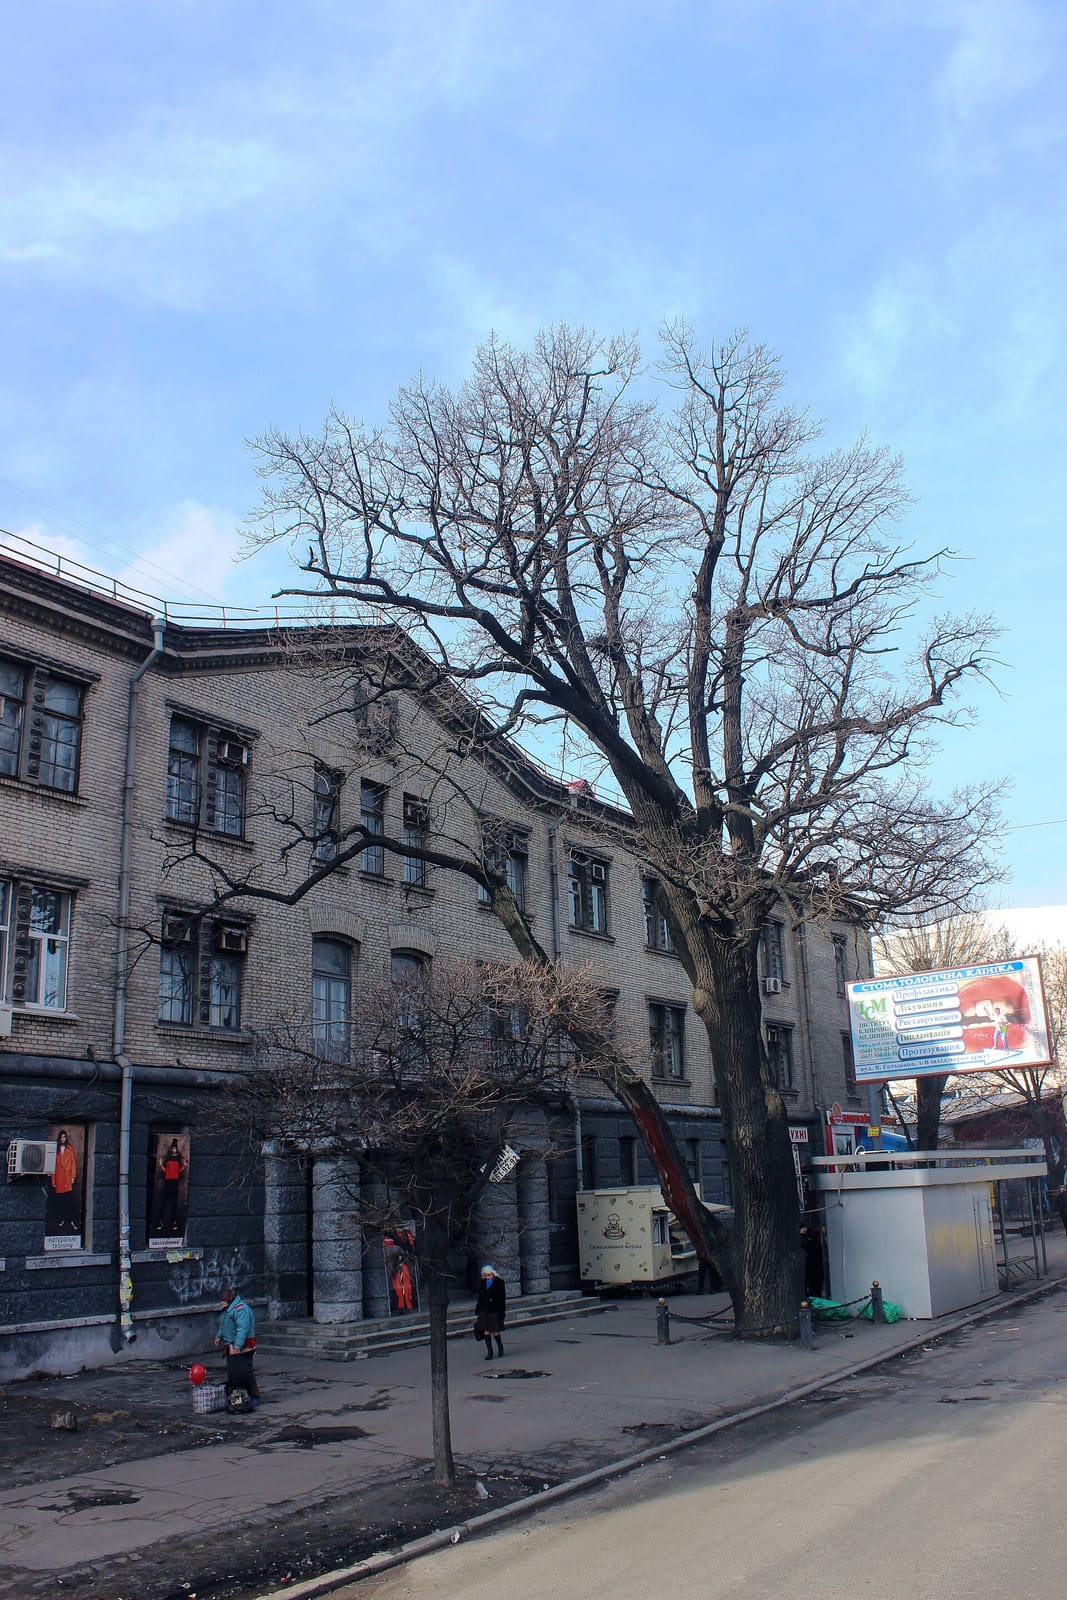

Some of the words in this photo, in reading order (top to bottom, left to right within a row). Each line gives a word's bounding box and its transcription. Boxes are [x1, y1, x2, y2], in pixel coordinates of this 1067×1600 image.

[861, 971, 964, 992] СТОМАТОЛОГІЧНА
[966, 963, 1015, 978] КЛІНІКА
[896, 985, 955, 1001] Профілактика
[898, 1001, 944, 1014] Лікування
[898, 1013, 960, 1028] Реставрування
[899, 1029, 951, 1042] Імплантація
[902, 1043, 960, 1058] Протезування
